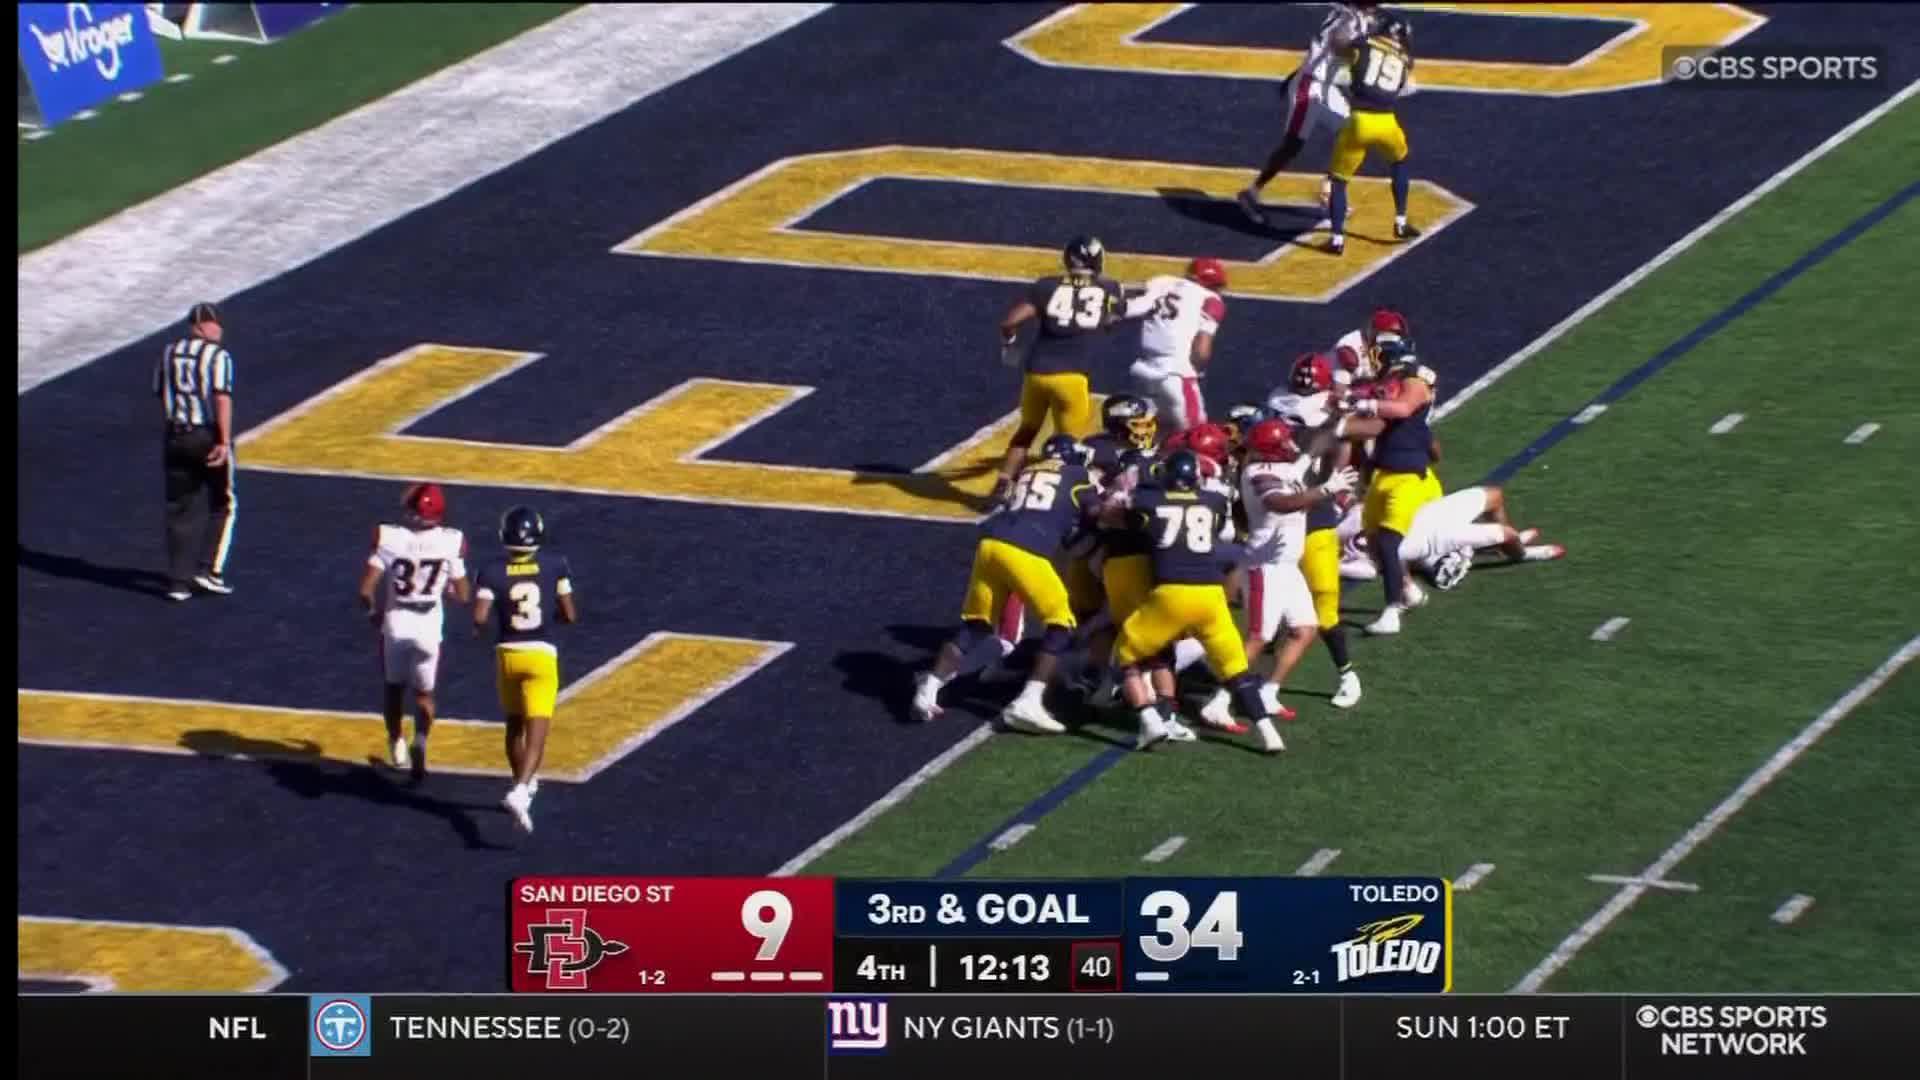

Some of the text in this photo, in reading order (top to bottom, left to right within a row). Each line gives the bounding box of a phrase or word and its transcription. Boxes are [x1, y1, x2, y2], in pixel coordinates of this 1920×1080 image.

[65, 3, 133, 80] Kroger
[1364, 48, 1404, 91] 19
[1046, 284, 1105, 328] 43
[1155, 505, 1213, 553] 78
[391, 558, 444, 595] 37
[509, 581, 542, 630] 3
